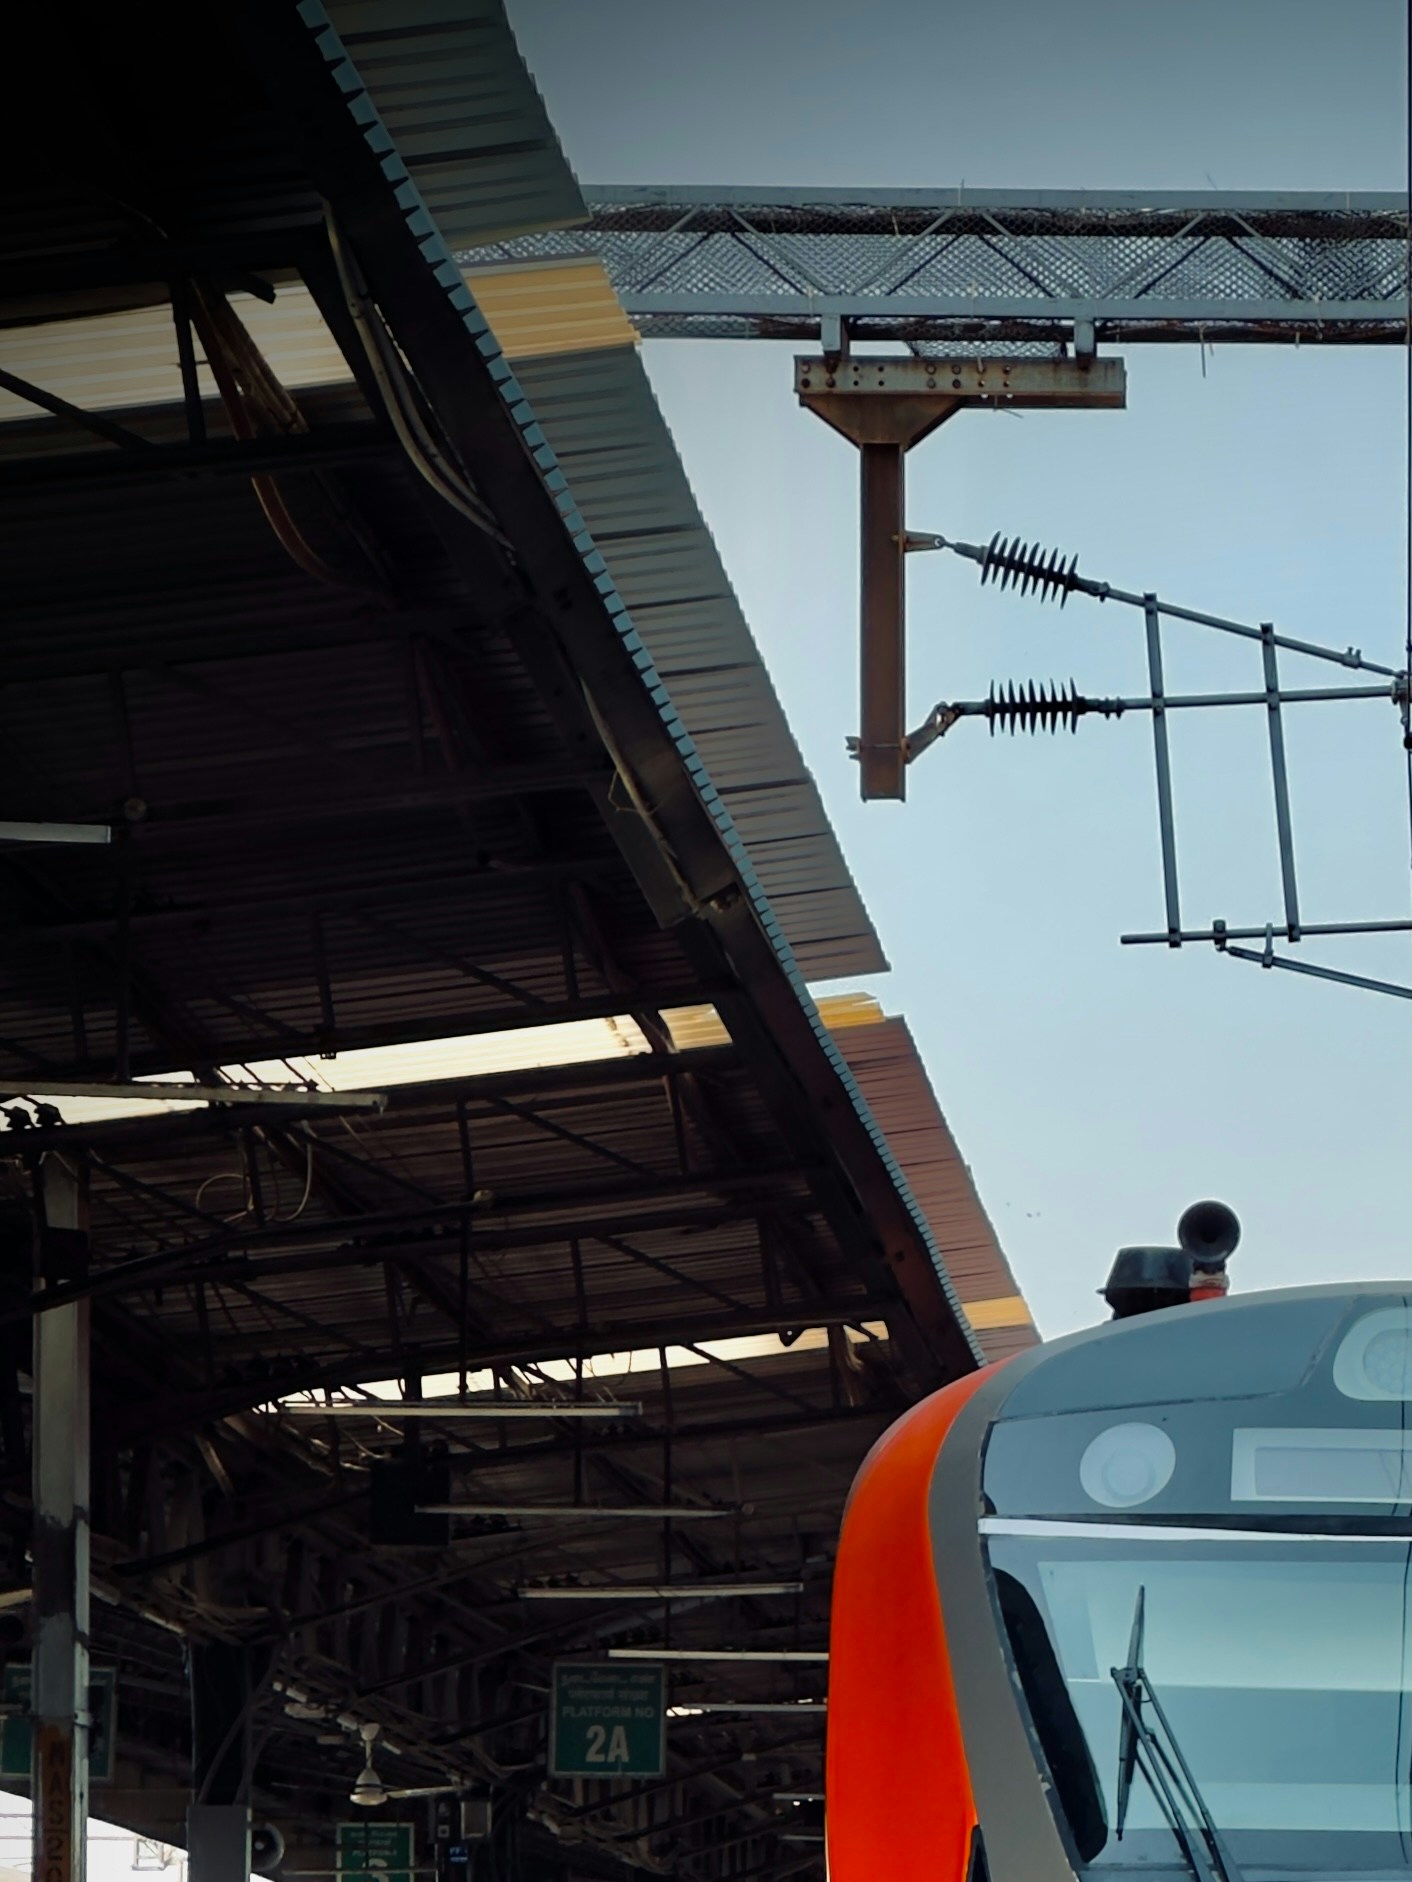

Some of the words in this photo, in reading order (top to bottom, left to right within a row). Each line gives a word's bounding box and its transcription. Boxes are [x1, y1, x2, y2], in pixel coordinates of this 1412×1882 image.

[561, 1705, 631, 1718] PLATFORM
[634, 1705, 655, 1718] NO
[584, 1724, 630, 1763] 2A
